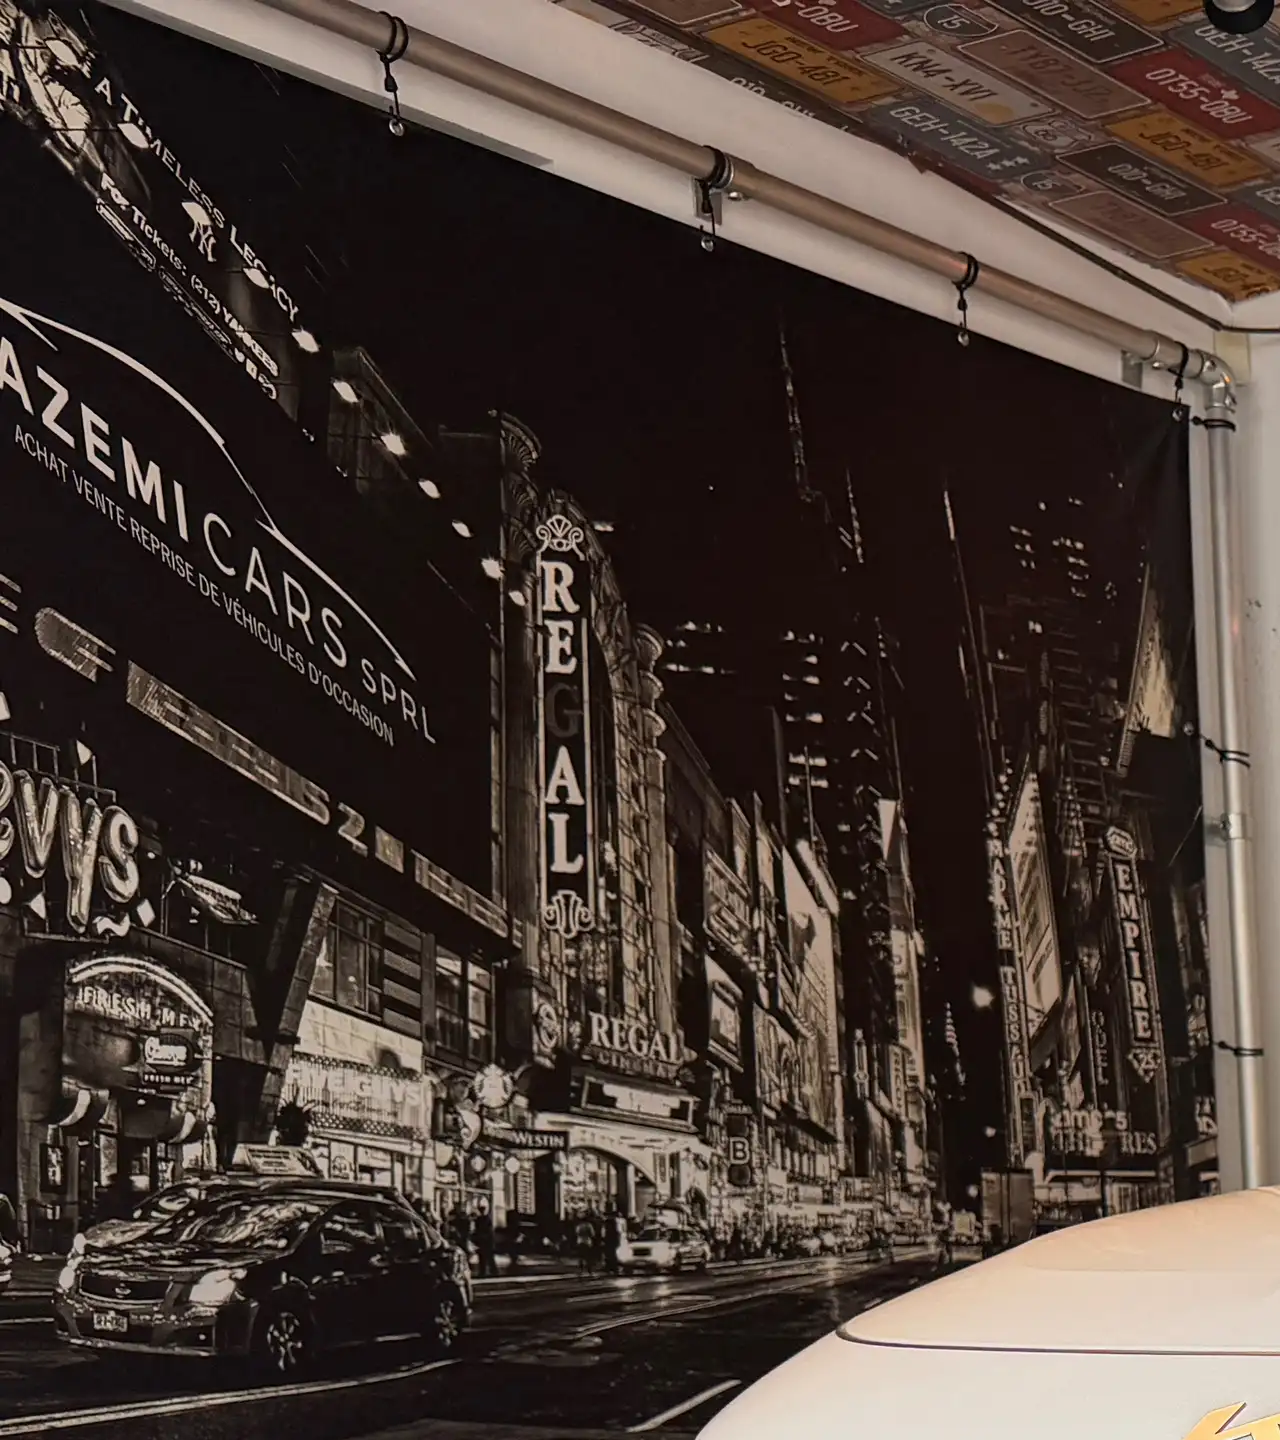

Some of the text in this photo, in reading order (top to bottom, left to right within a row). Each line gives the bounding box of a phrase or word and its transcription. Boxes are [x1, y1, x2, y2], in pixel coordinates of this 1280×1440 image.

[14, 424, 395, 748] ACHAT VENTE REPRISE DE VÉHICULES D'OCCASION
[203, 511, 348, 669] CARS
[360, 657, 436, 744] SPRL
[539, 560, 585, 874] REGAL
[588, 1010, 685, 1065] REGAL
[1114, 861, 1152, 1040] EMPIRE
